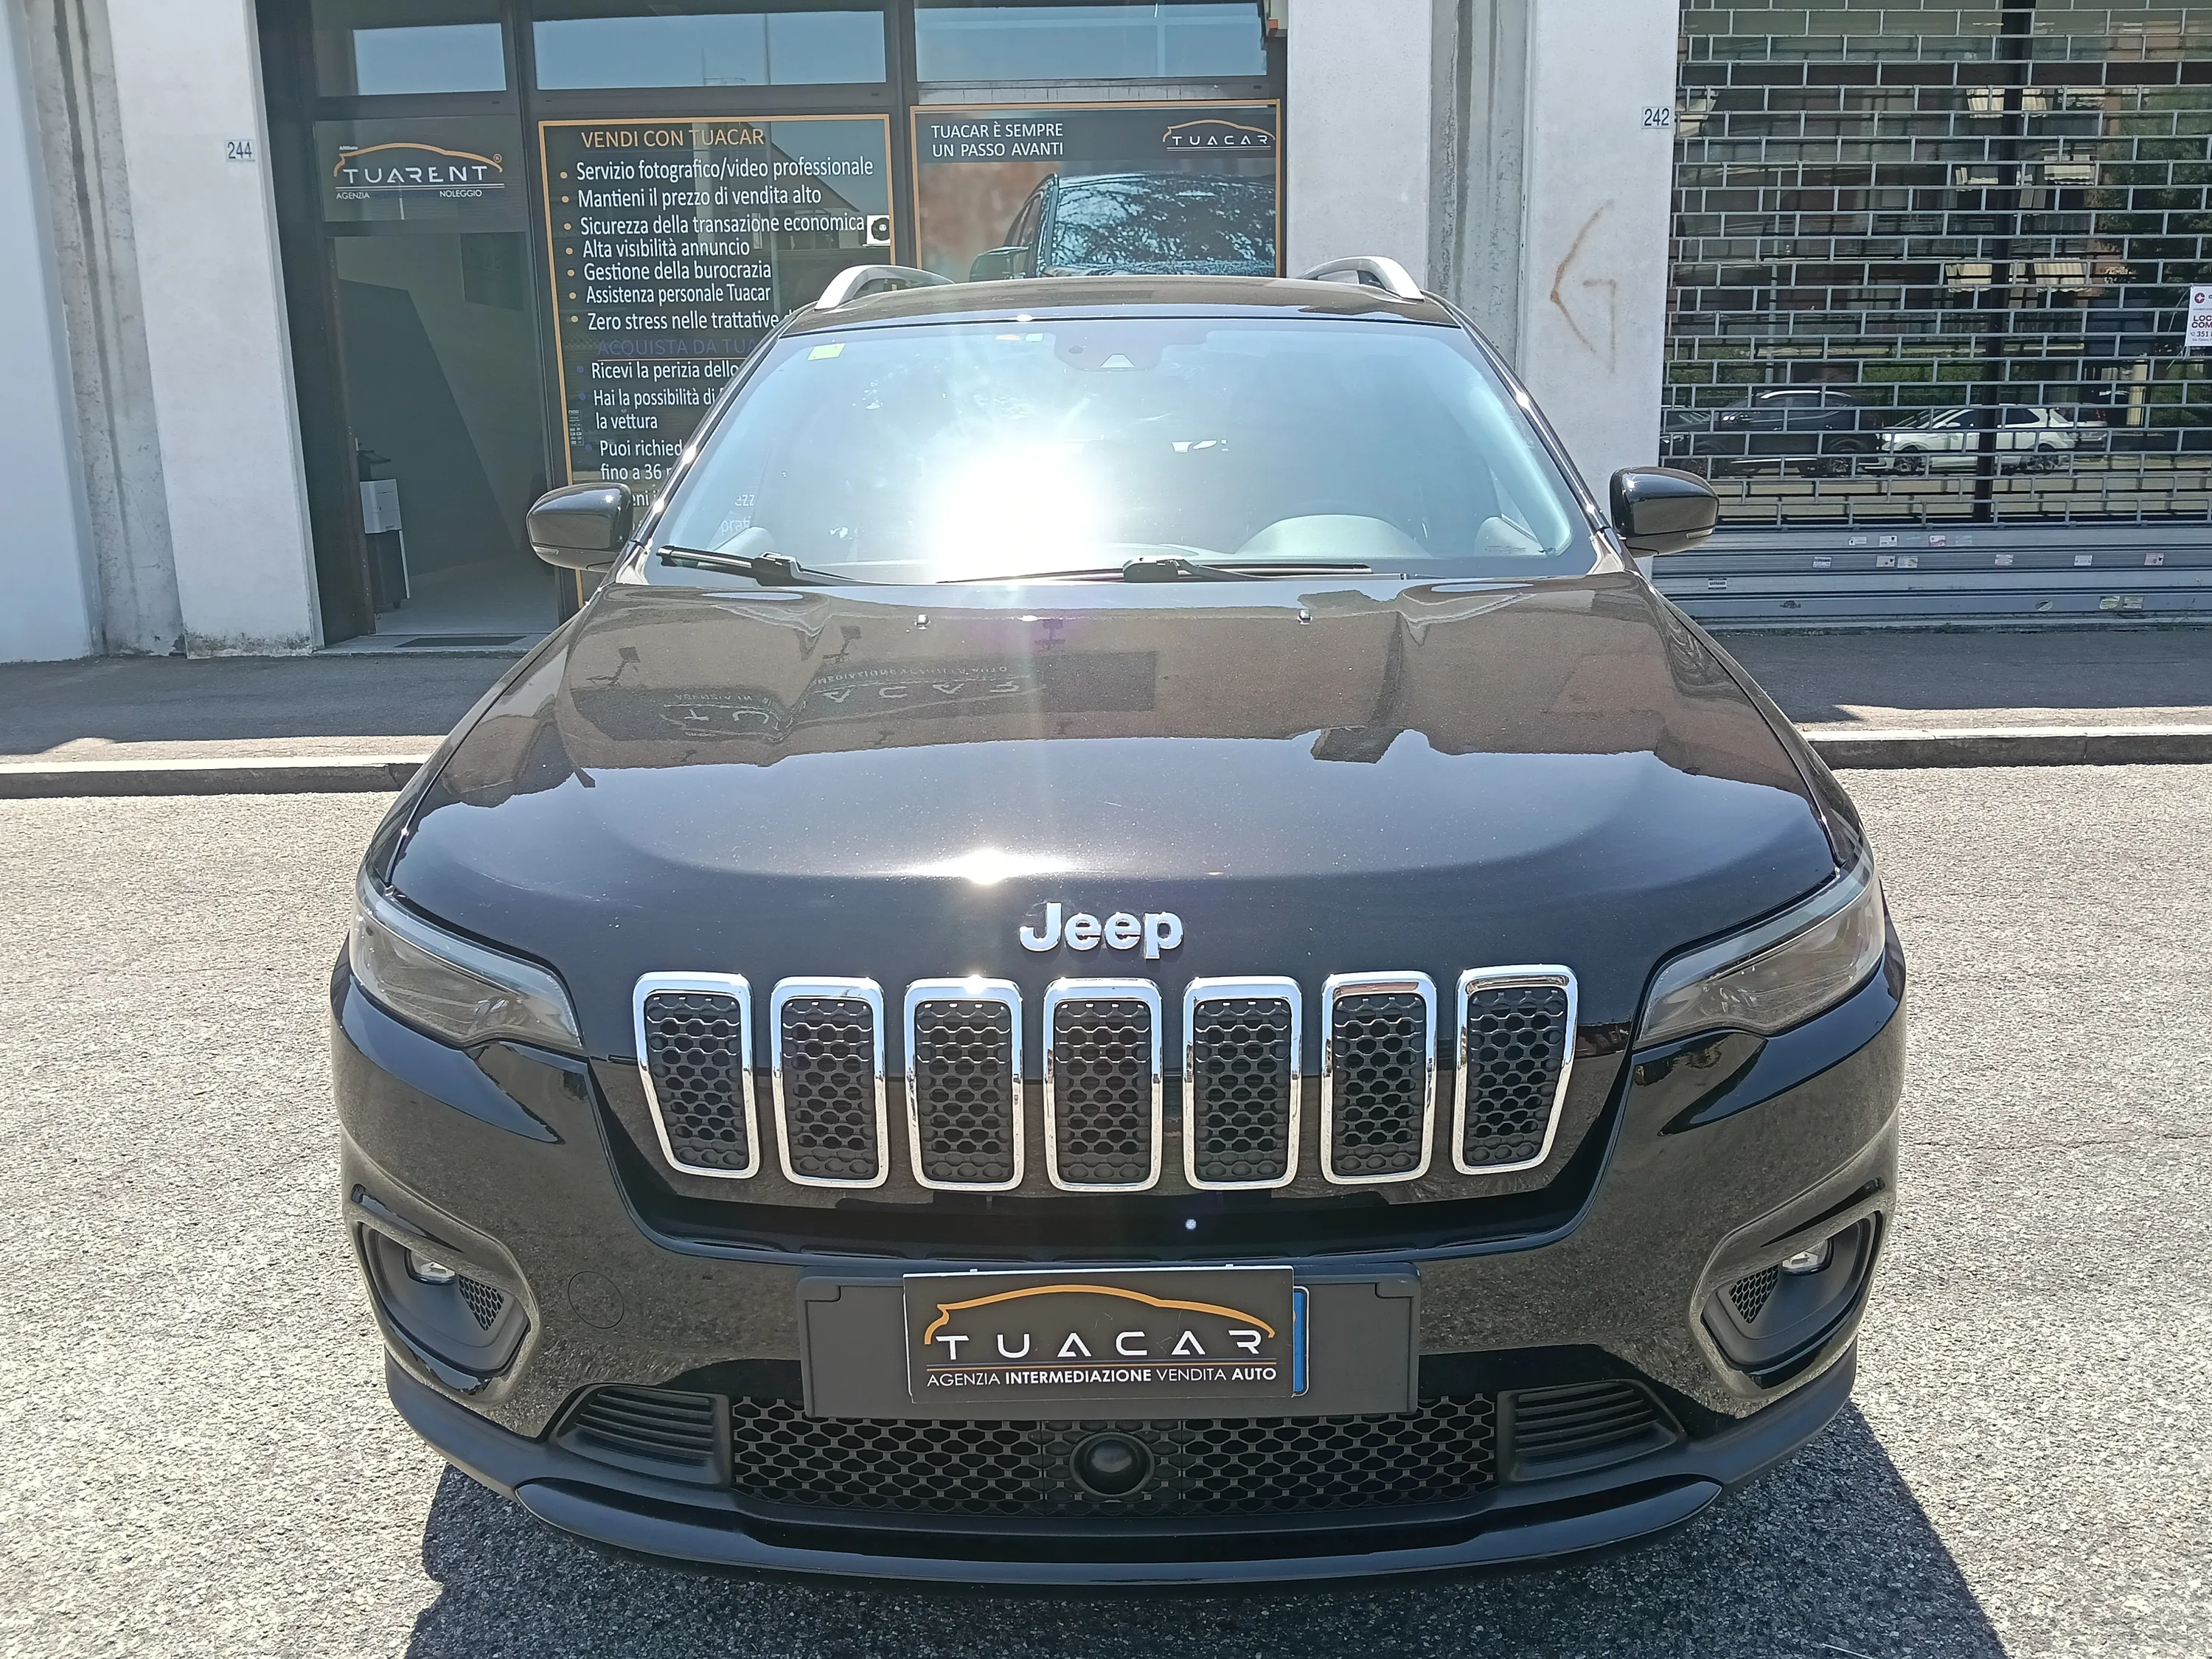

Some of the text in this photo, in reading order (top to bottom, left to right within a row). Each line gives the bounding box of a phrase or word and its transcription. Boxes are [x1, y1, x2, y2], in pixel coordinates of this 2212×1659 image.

[1644, 108, 1669, 126] 242
[581, 128, 764, 148] VENDI CON TUACAR
[931, 122, 1063, 138] TUACAR È SEMPRE
[227, 141, 252, 159] 244
[933, 142, 1063, 157] UN PASSO AVANTI
[1172, 135, 1268, 146] TUACAR
[343, 165, 488, 184] TUARENT
[577, 156, 874, 184] Servizio fotografico/video professionale
[439, 189, 482, 198] NOLEGGIO
[578, 184, 822, 211] Mantieni il prezzo di vendita alto
[580, 212, 864, 235] Sicurezza della transazione economica
[583, 238, 613, 258] Alta
[681, 237, 750, 257] annuncio
[584, 260, 771, 281] Gestione della burocrazia
[586, 282, 771, 307] Assistenza personale Tuacar
[588, 313, 622, 330] Zero
[625, 313, 668, 330] stress
[672, 310, 708, 329] nelle
[711, 310, 779, 329] trattative
[598, 339, 689, 358] ACQUISTA
[694, 339, 717, 355] DA
[591, 360, 739, 383] Ricevi la perizia dello
[594, 387, 715, 409] Hai la possibilità di
[596, 412, 658, 429] la vettura
[599, 439, 683, 456] Puoi richied
[600, 462, 628, 480] fino
[632, 467, 640, 480] a
[644, 463, 662, 480] 36
[1020, 902, 1183, 959] Jeep
[935, 1329, 1262, 1360] TUACAR
[927, 1367, 1277, 1387] AGENZIA INTERMEDIAZIONE VENDITA AUTO
